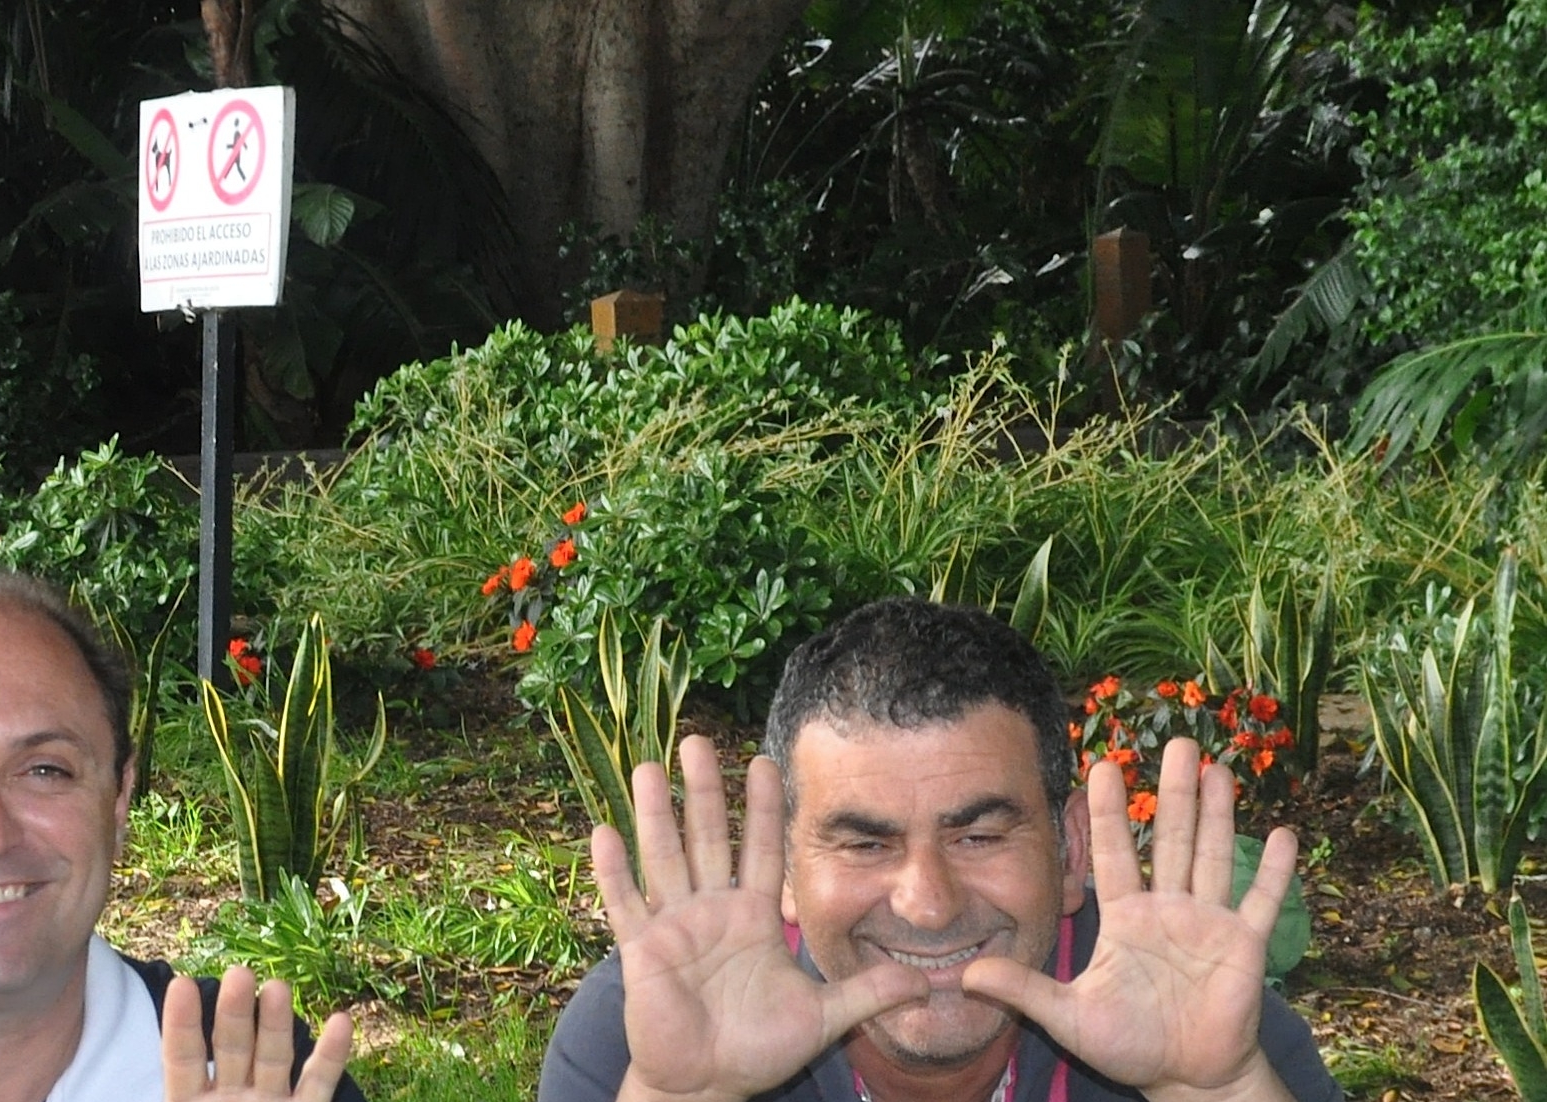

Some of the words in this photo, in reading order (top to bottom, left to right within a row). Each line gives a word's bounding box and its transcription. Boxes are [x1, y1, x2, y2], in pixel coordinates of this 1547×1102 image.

[151, 226, 195, 245] PROHIBIDO
[197, 226, 207, 241] EL
[209, 222, 252, 240] ACCESO
[150, 255, 162, 271] LAS
[163, 253, 190, 269] ZONAS
[191, 248, 266, 271] AJARDINADAS
